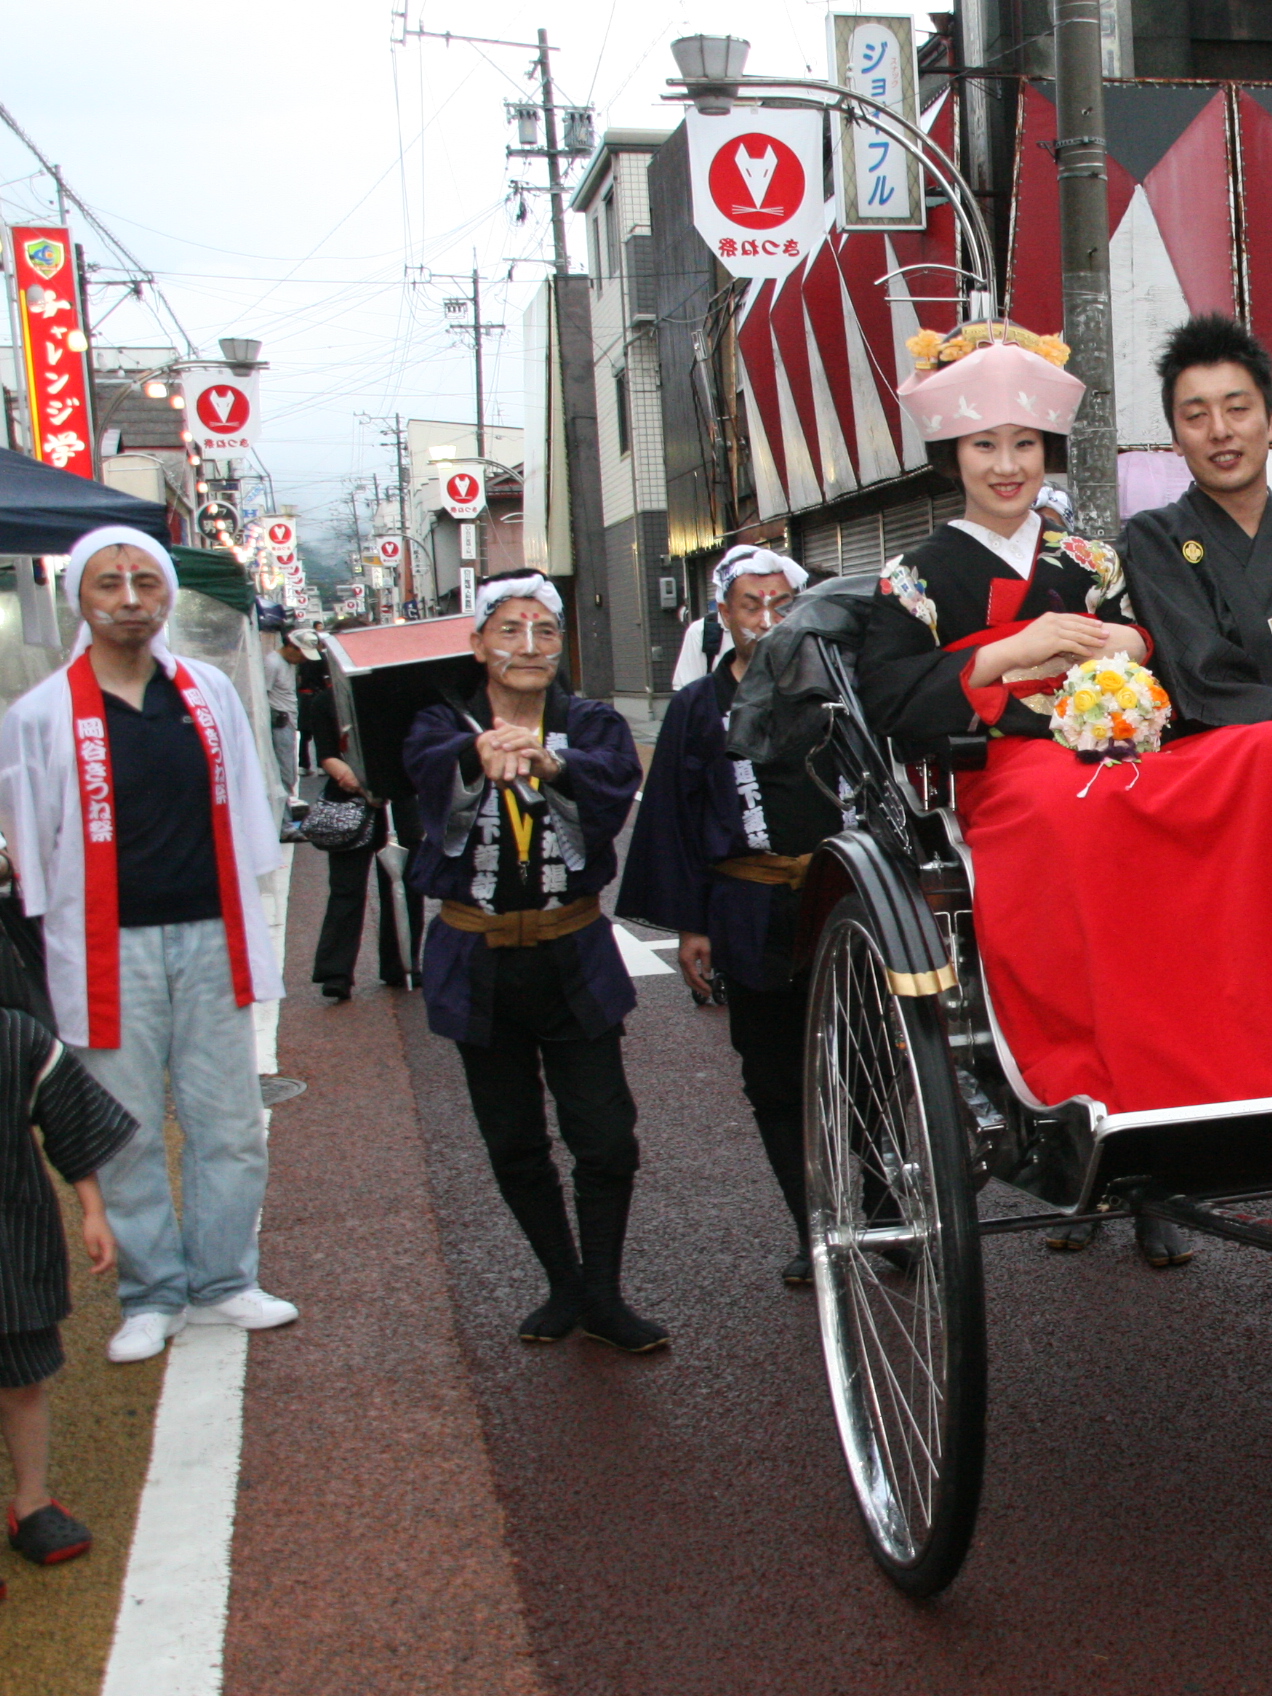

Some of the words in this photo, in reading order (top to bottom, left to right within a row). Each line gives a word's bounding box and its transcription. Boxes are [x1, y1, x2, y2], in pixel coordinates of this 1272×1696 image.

[861, 40, 895, 207] ジョイフル
